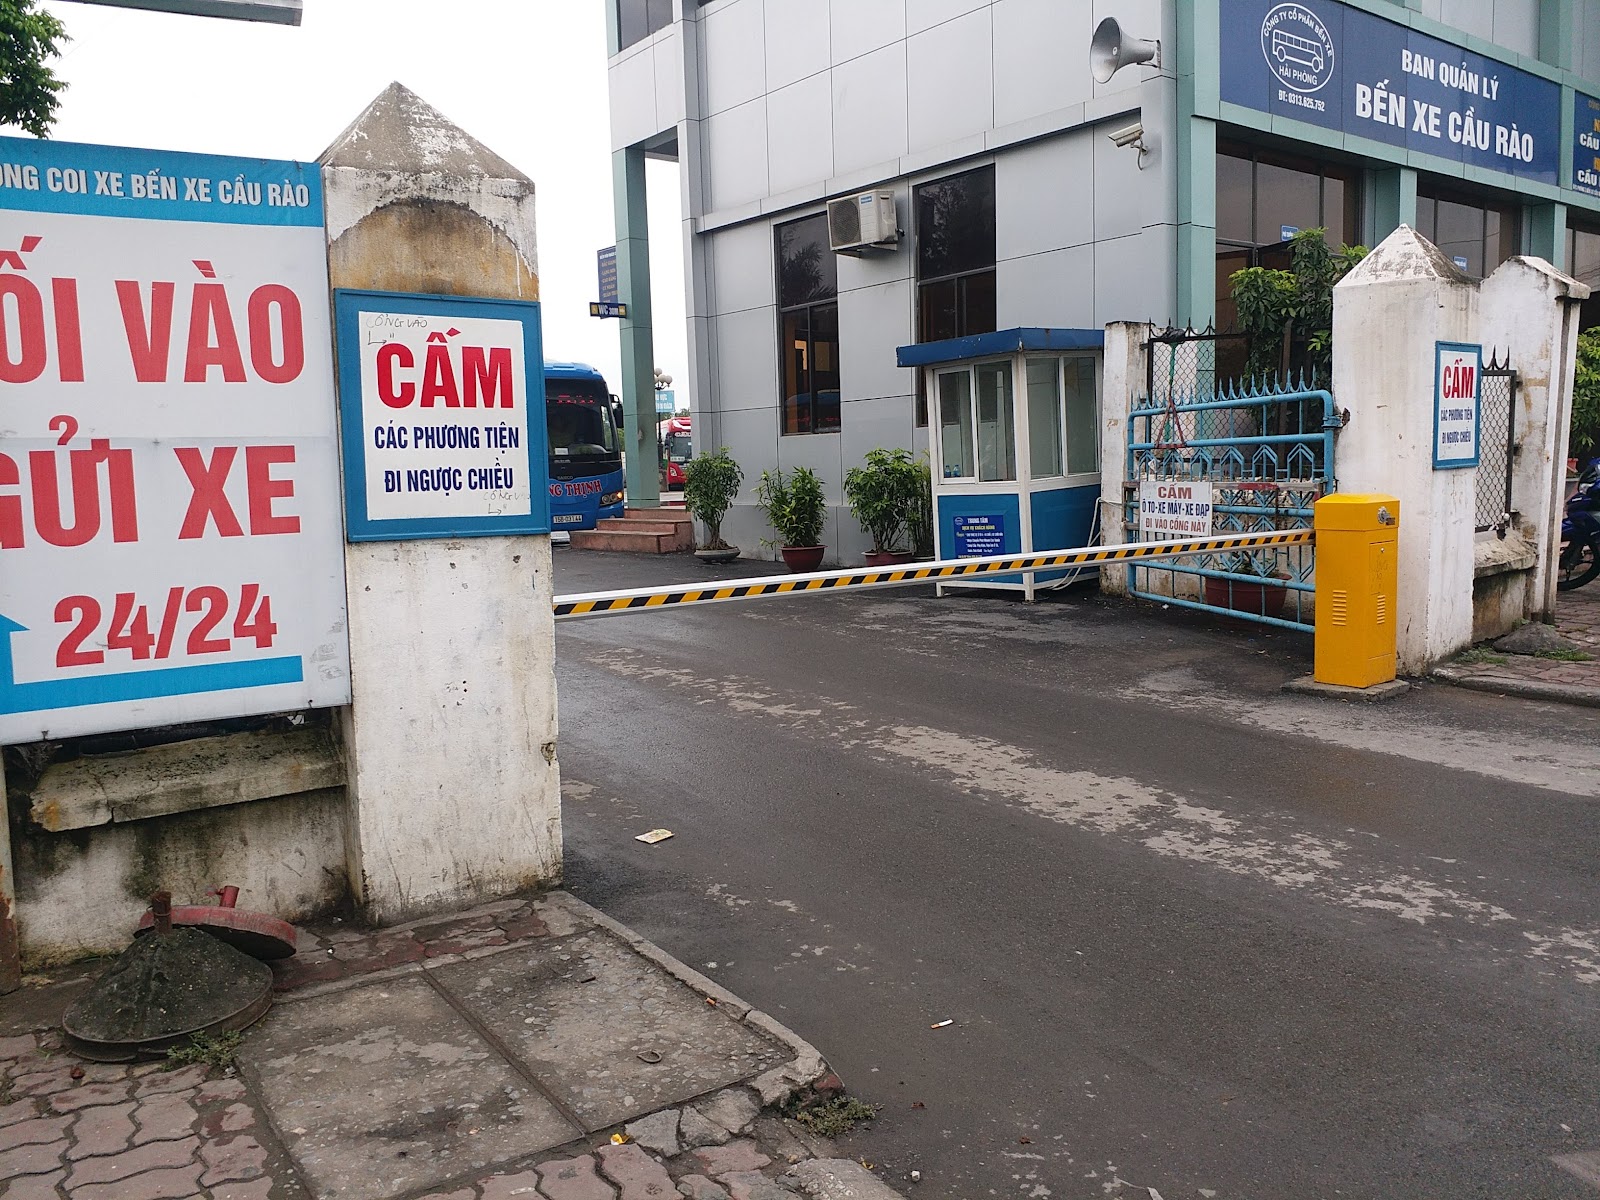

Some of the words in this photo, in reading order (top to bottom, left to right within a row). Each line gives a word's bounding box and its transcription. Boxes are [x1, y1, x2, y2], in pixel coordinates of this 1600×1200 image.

[1279, 11, 1287, 21] TY
[1279, 63, 1291, 79] HẢI
[1292, 70, 1318, 85] PHÒNG
[1402, 49, 1435, 81] BAN
[1439, 62, 1478, 95] QUẢN
[1482, 75, 1499, 101] LÝ
[1356, 79, 1405, 128] BẾN
[1412, 100, 1441, 138] XE
[1448, 106, 1490, 151] CẦU
[1496, 123, 1534, 163] RÀO
[0, 162, 39, 191] NG
[46, 166, 87, 194] COI
[95, 170, 124, 197] XE
[131, 168, 177, 201] BẾN
[184, 178, 212, 203] XE
[218, 174, 262, 206] CẦU
[268, 179, 310, 207] RÀO
[114, 259, 305, 384] VÀO
[376, 327, 514, 409] CẤM
[1443, 358, 1474, 399] CẤM
[374, 420, 408, 449] CÁC
[414, 424, 480, 449] PHƯƠNG
[484, 422, 519, 454] TIỆN
[172, 445, 301, 540] XE
[384, 470, 401, 493] ĐI
[407, 467, 463, 496] NGƯỢC
[468, 458, 514, 490] CHIỀU
[565, 479, 603, 498] THỊNH
[1158, 483, 1192, 500] CẤM
[1145, 518, 1152, 528] ĐI
[1154, 517, 1167, 530] VÀO
[1190, 519, 1206, 533] NÀY
[1195, 503, 1210, 519] ĐẠP
[53, 583, 278, 668] 24/24
